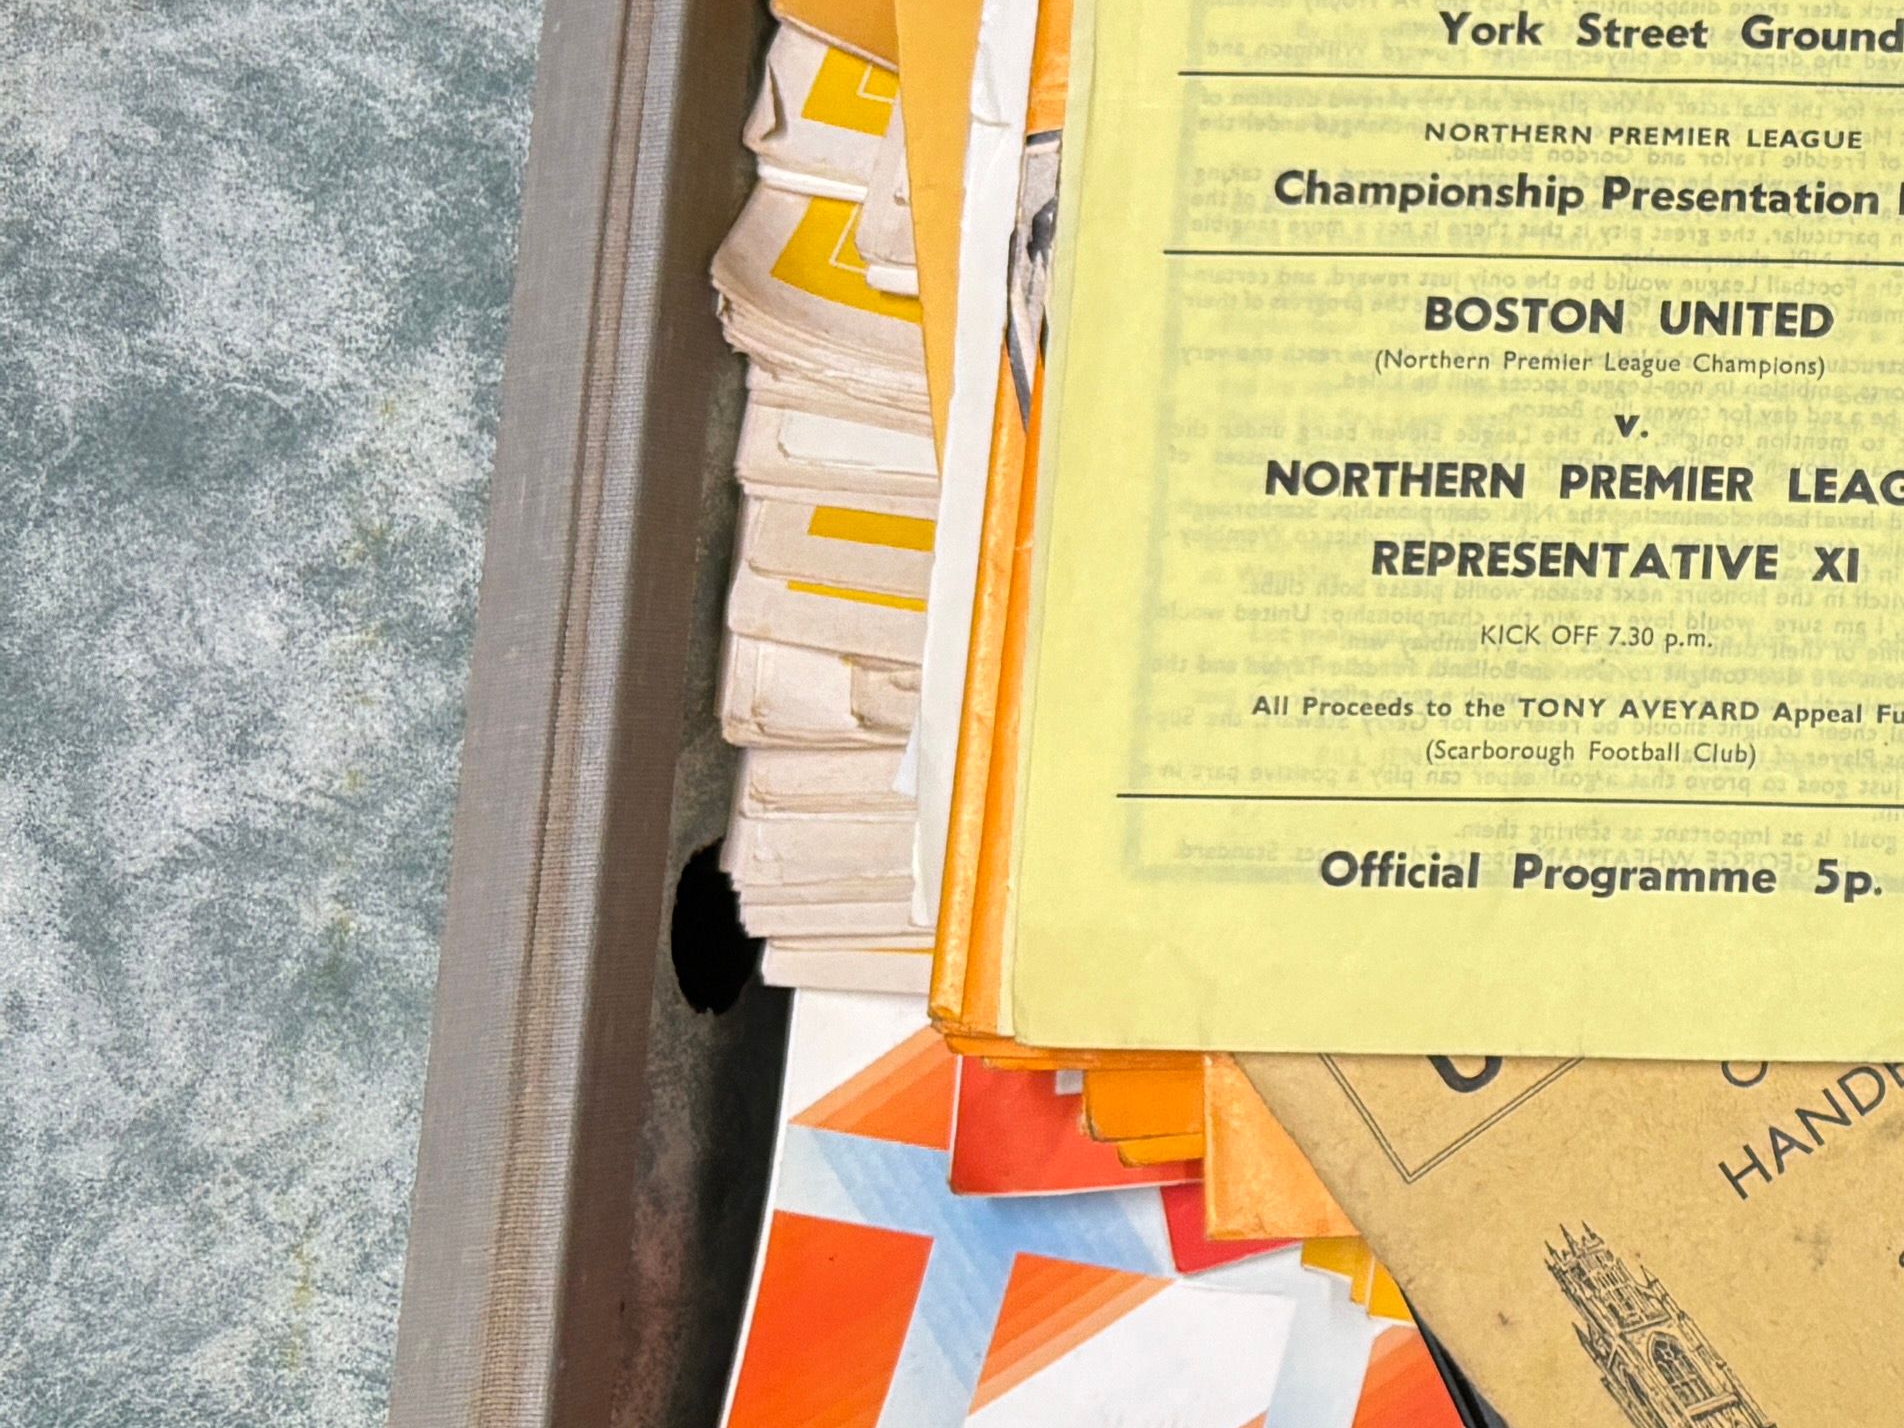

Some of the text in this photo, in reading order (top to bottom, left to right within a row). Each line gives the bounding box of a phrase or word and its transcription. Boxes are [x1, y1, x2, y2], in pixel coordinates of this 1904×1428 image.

[1439, 11, 1904, 52] York Street Ground
[1423, 121, 1861, 148] NORTHERN PREMIER LEAGUE
[1275, 170, 1584, 215] Championship
[1602, 176, 1878, 214] Presentation
[1425, 296, 1833, 337] BOSTON UNITED
[1373, 348, 1828, 382] (Northern Premier League Champions)
[1615, 415, 1648, 437] v.
[1266, 460, 1524, 498] NORTHERN
[1560, 464, 1753, 501] PREMIER
[1372, 541, 1859, 582] REPRESENTATIVE XI
[1481, 625, 1712, 653] KICK OFF 7.30 p.m.
[1252, 696, 1288, 715] All
[1303, 697, 1413, 716] Proceeds
[1427, 700, 1451, 716] to
[1465, 698, 1505, 717] the
[1518, 698, 1605, 717] TONY
[1619, 699, 1759, 720] AVEYARD
[1773, 702, 1861, 728] Appeal
[1426, 740, 1755, 769] (Scarborough Football Club)
[1321, 851, 1881, 902] Official Programme 5p.
